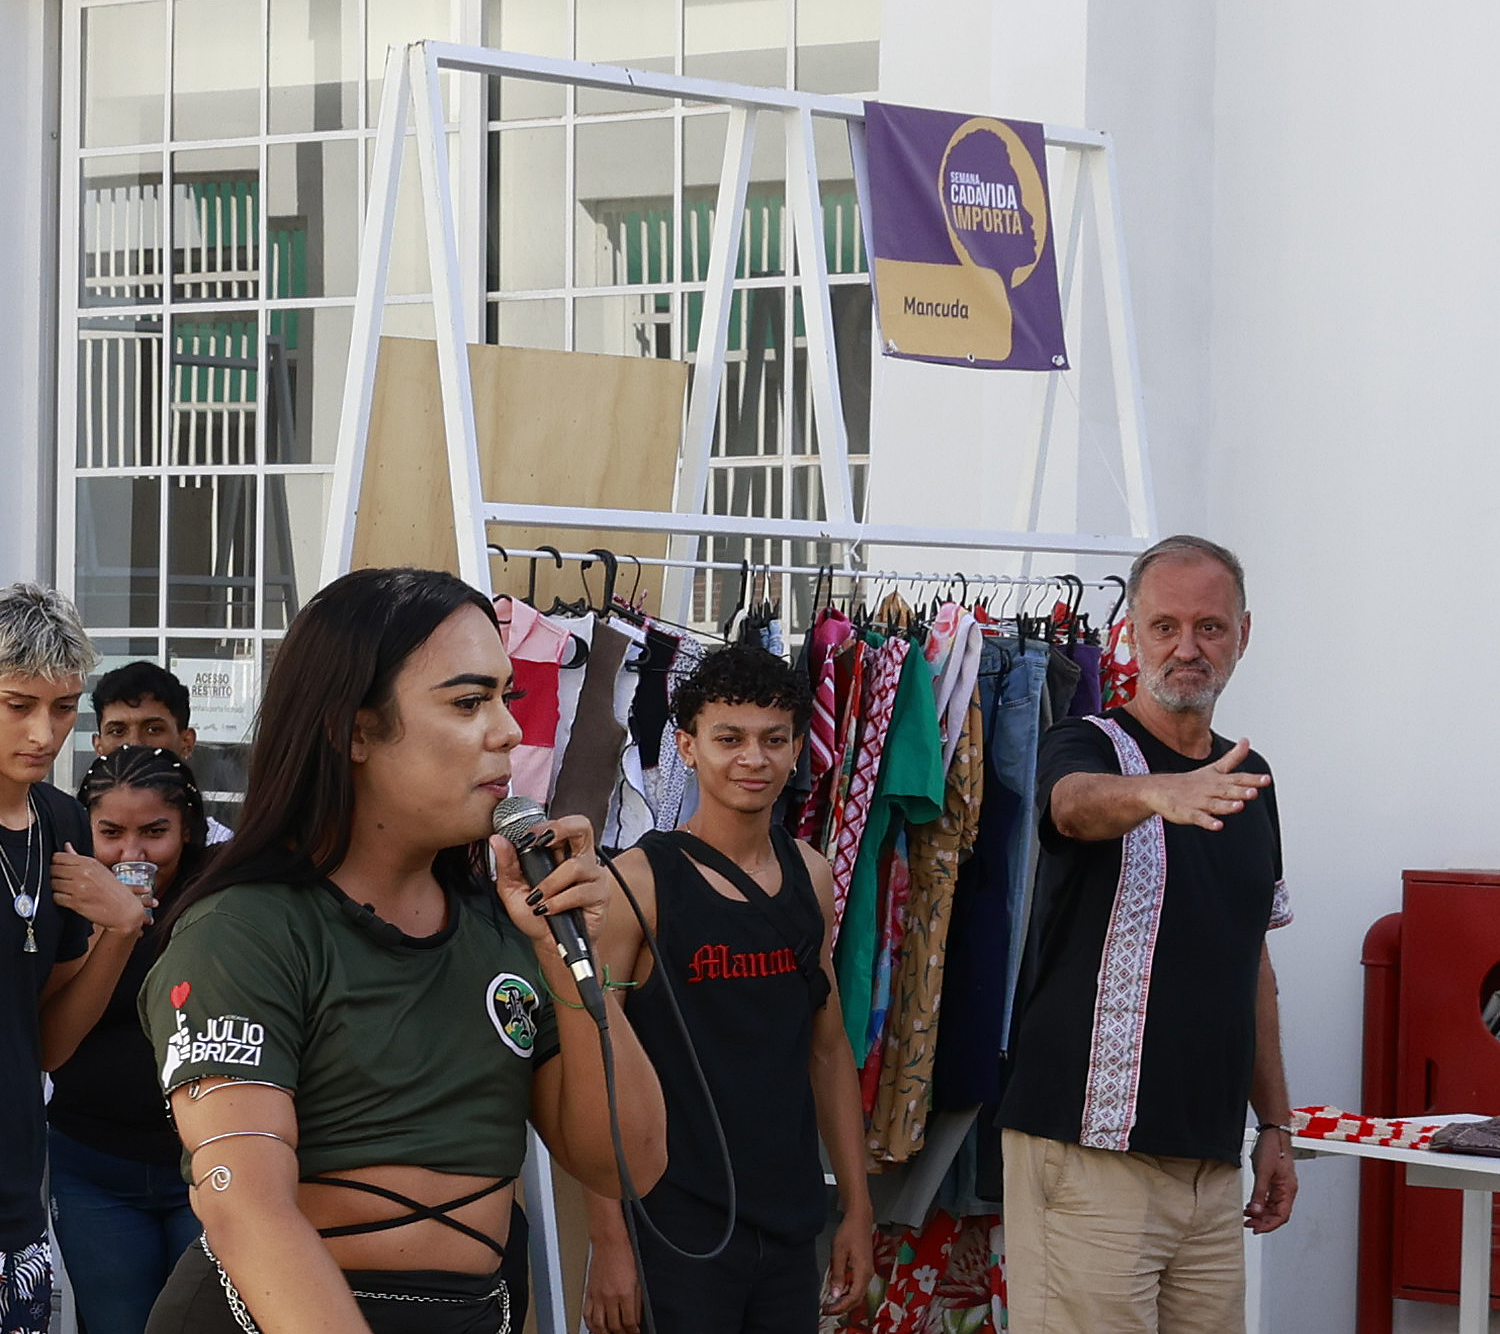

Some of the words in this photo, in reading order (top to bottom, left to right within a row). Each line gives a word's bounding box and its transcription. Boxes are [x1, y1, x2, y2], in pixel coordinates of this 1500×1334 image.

[950, 171, 980, 185] SEMANA
[951, 183, 984, 206] CADA
[979, 182, 1018, 210] VIDA
[951, 204, 1023, 235] IMPORTA
[903, 296, 970, 320] Mancuda
[195, 672, 230, 685] ACESSO
[191, 685, 233, 698] RESTRITO
[196, 1015, 265, 1046] JÚLIO
[191, 1041, 262, 1067] BRIZZI
